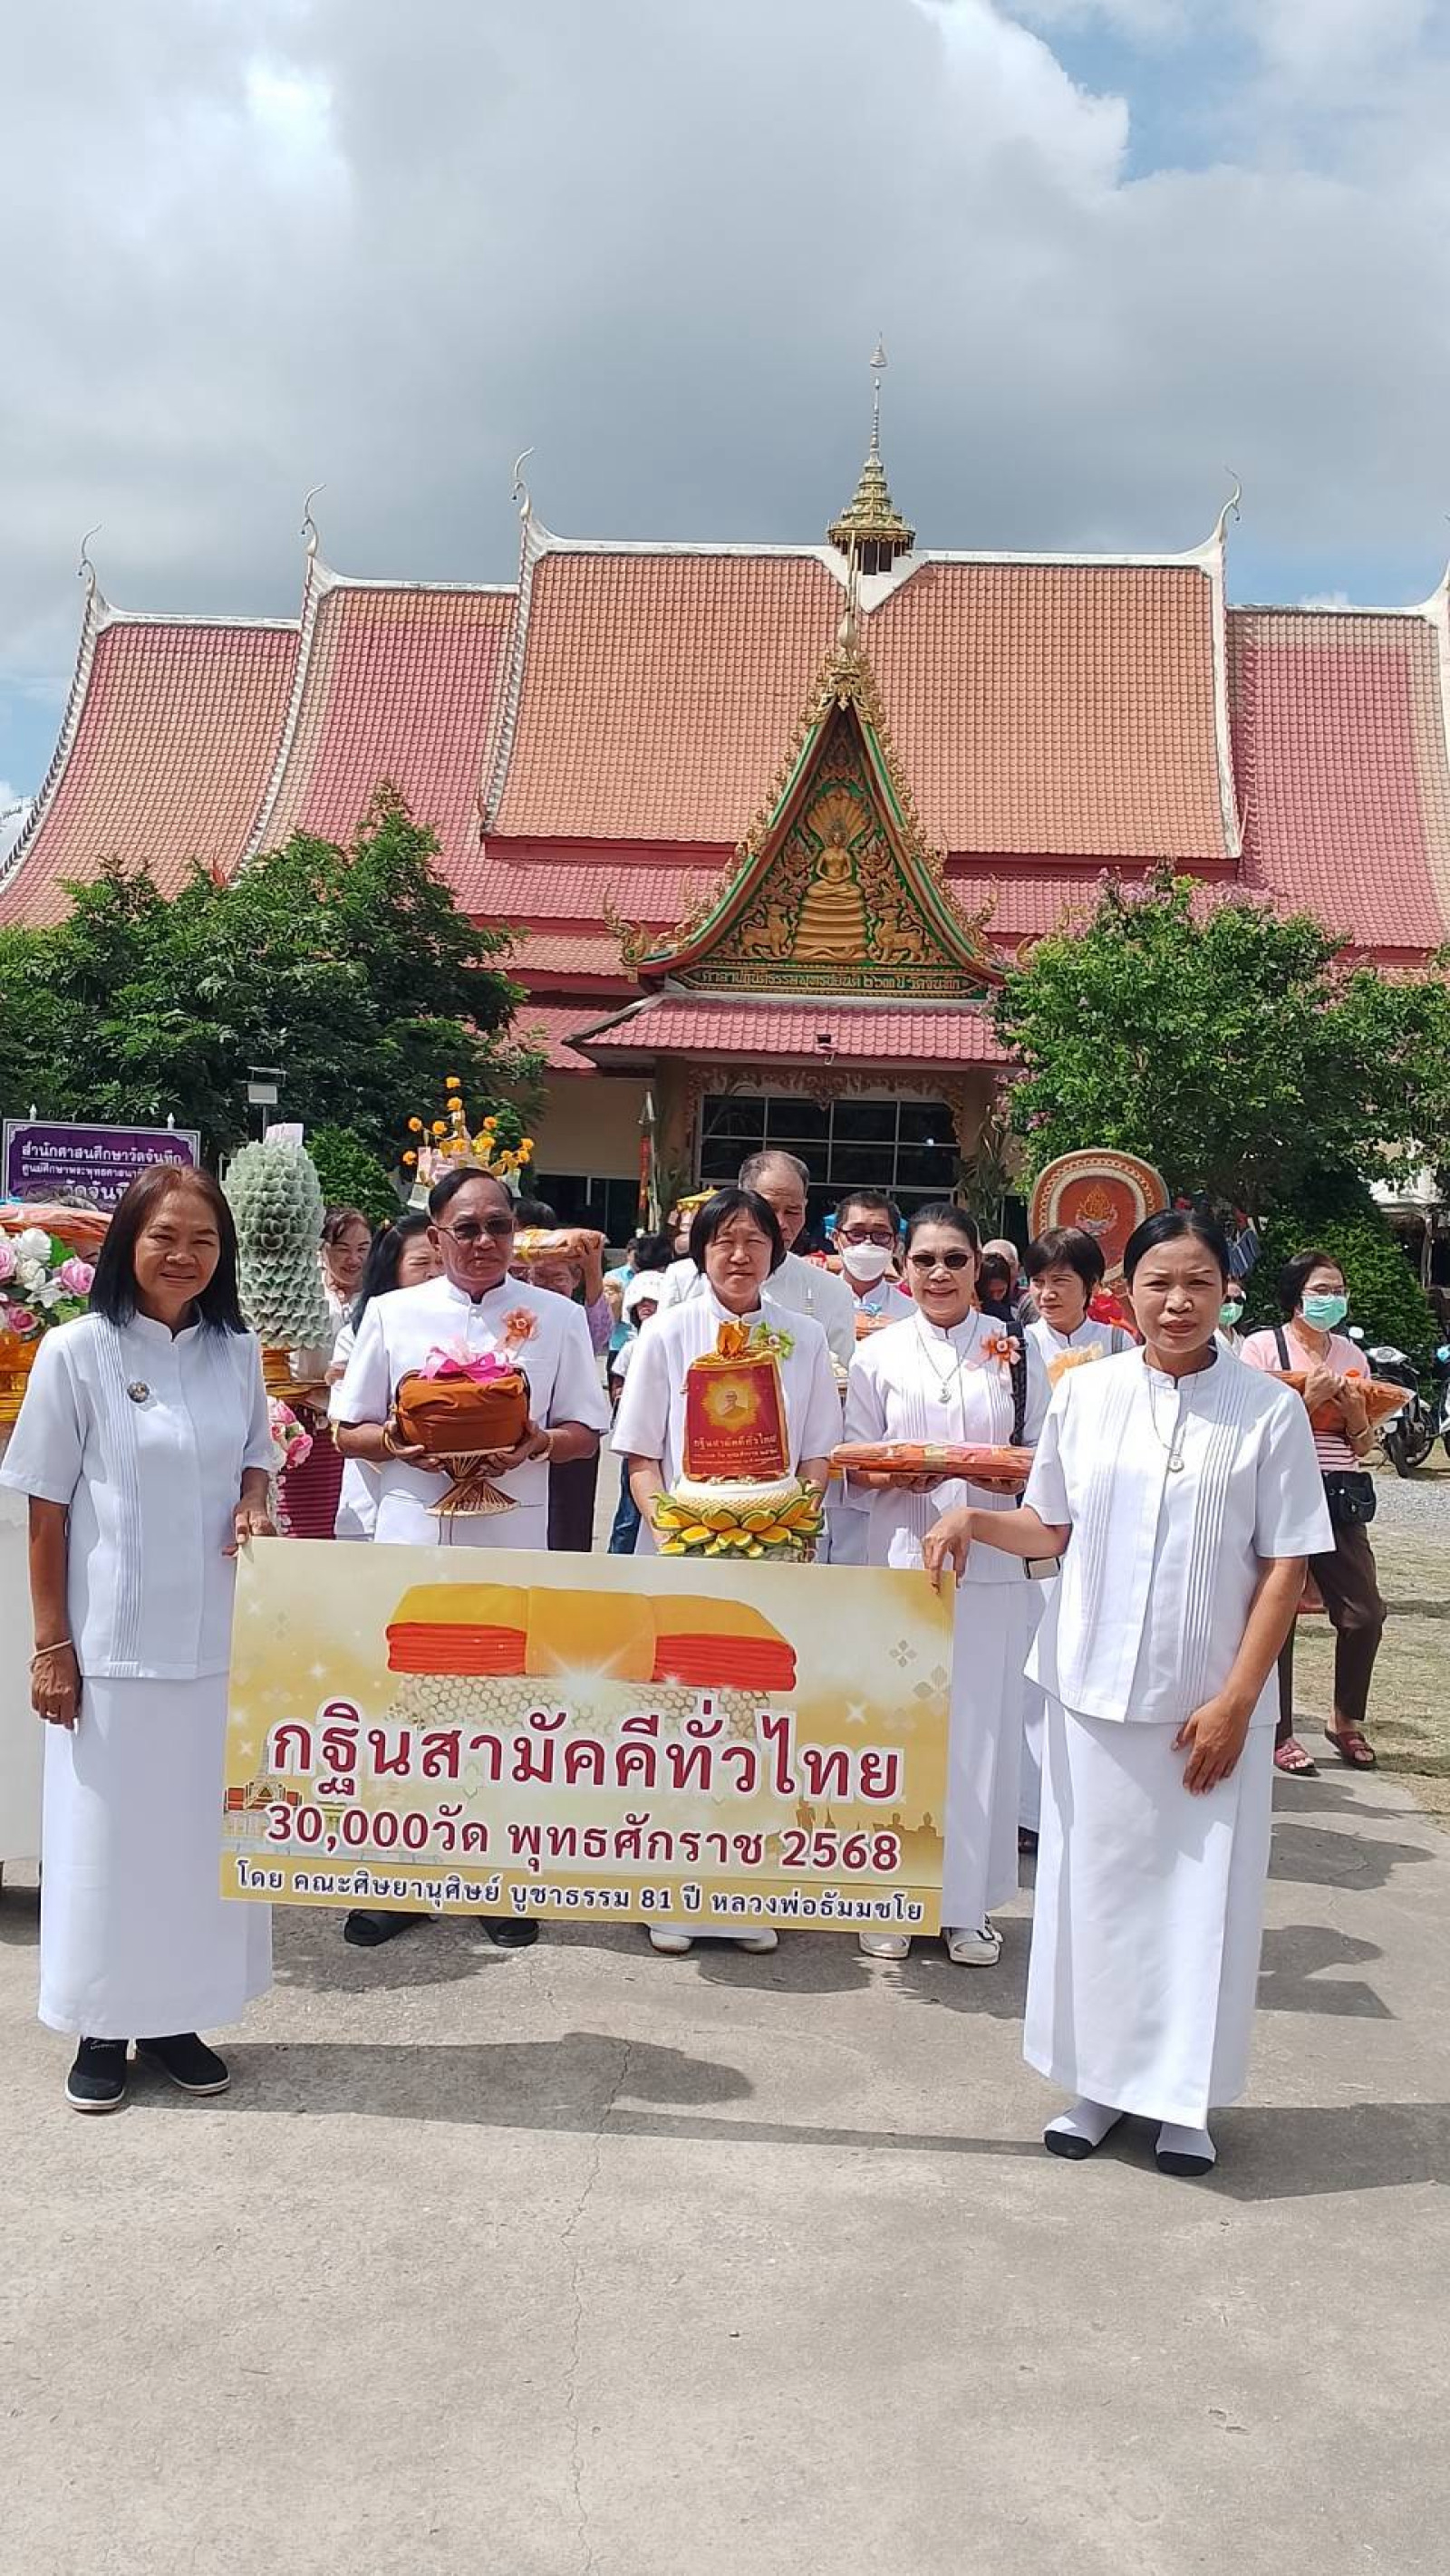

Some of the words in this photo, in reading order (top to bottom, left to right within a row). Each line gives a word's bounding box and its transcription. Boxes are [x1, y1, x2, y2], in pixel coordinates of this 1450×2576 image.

[22, 1141, 182, 1165] สำนักศาสนศึกษาวัดจันทึก
[22, 1163, 143, 1180] ศูนย์ศึกษาพระพุทธศาสนา
[274, 1700, 898, 1799] กฐินสามัคคีทั่วไทย
[268, 1803, 488, 1852] 30,000วัด
[508, 1812, 762, 1872] พุทธศักราช
[781, 1831, 899, 1871] 2568
[237, 1859, 283, 1888] โดย
[294, 1870, 501, 1907] คณะศิษยานุศิษย์
[510, 1884, 629, 1913] บูชาธรรม
[640, 1887, 672, 1909] 81
[682, 1885, 701, 1911] ปี
[711, 1888, 923, 1922] หลวงพ่อธัมมชโย
